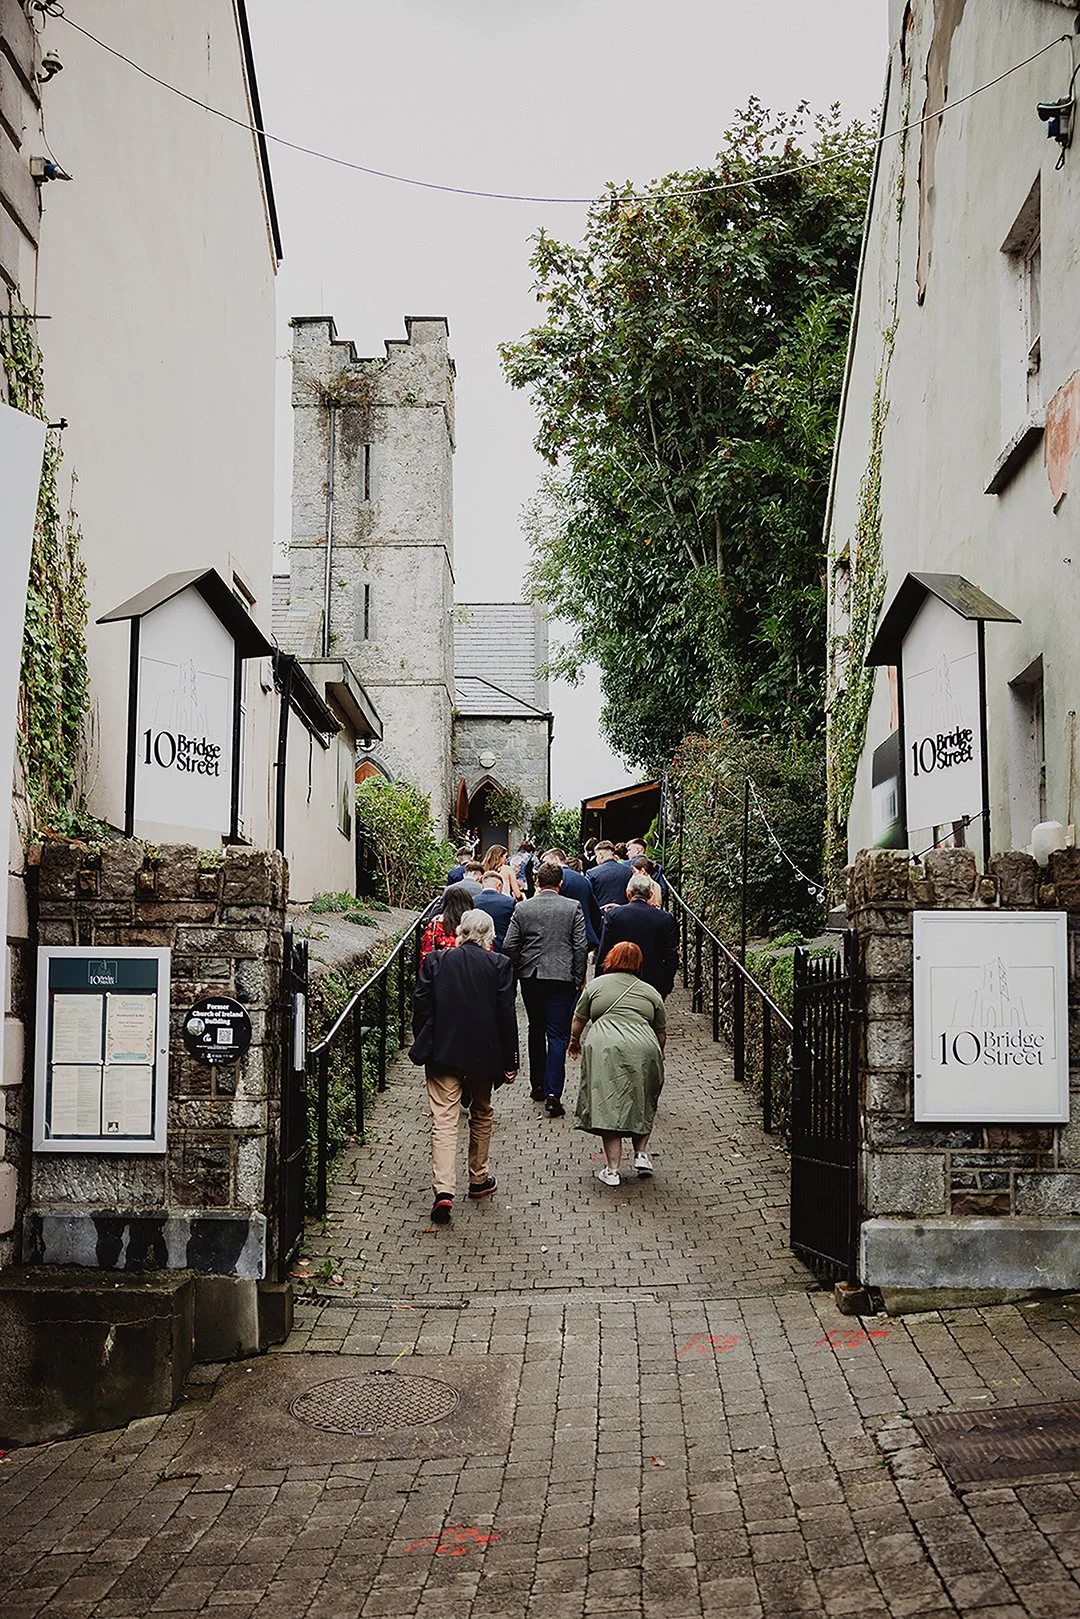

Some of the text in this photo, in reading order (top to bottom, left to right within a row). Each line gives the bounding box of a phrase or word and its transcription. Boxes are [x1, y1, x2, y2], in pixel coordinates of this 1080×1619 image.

[143, 728, 222, 768] 10 Bridge
[911, 725, 973, 777] 10 Bridge
[936, 744, 974, 770] Street
[176, 752, 220, 777] Street
[221, 1010, 244, 1018] Ireland
[938, 1029, 1045, 1066] 10 Bridge
[983, 1048, 1044, 1066] Street
